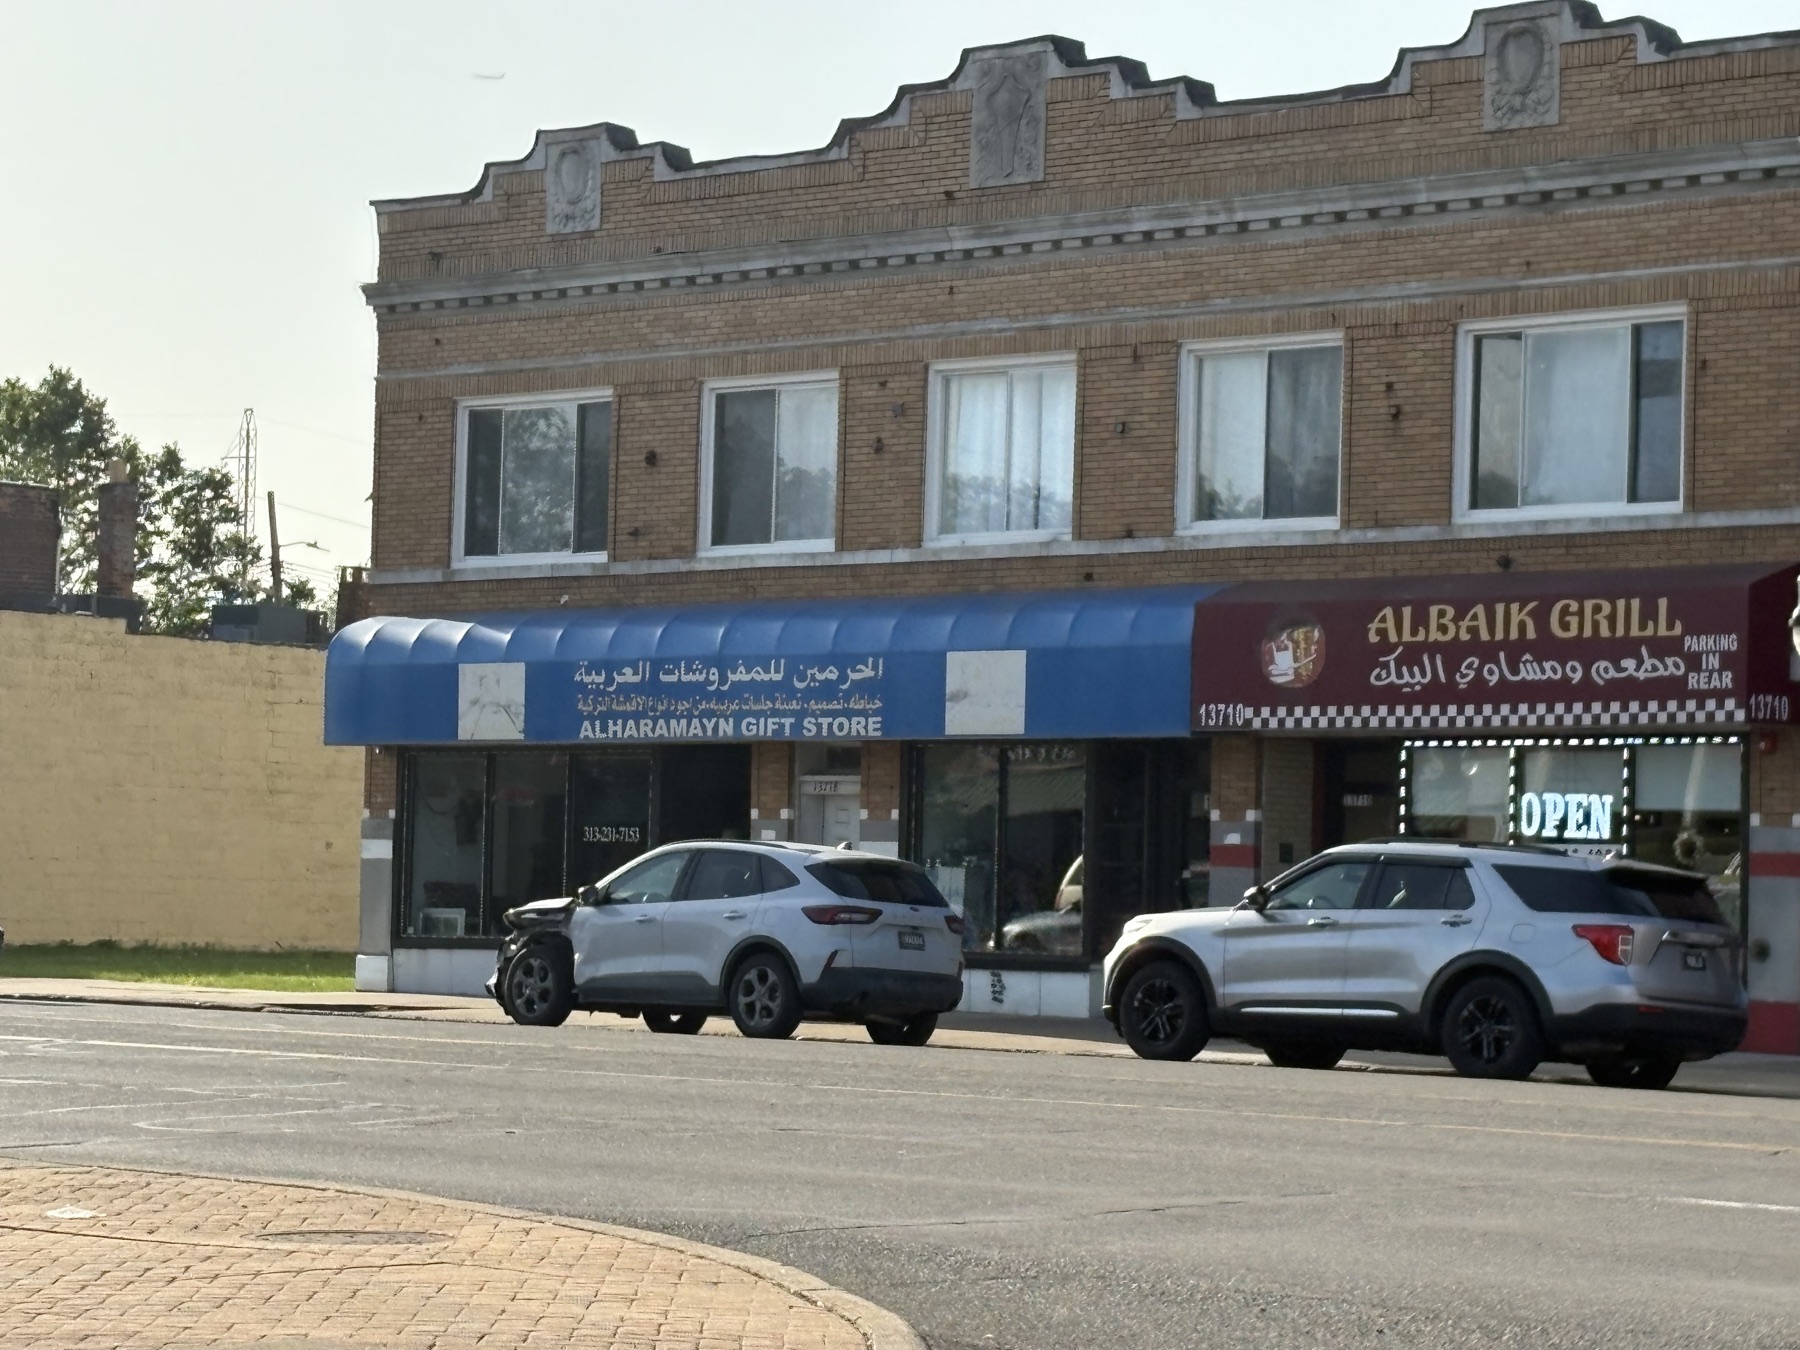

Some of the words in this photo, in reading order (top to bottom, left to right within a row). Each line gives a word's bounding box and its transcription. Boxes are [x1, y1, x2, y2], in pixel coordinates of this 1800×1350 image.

[1367, 601, 1539, 643] ALBAIK
[1549, 597, 1682, 638] GRILL
[1684, 633, 1738, 652] PARKING
[573, 660, 650, 691] العربية
[658, 658, 786, 691] للمفروشات
[793, 656, 884, 689] الحرمين
[1369, 646, 1446, 691] البيك
[1455, 651, 1583, 689] ومشاوي
[1591, 645, 1686, 685] مطعم
[1702, 652, 1720, 670] IN
[1687, 671, 1733, 690] REAR
[1199, 703, 1245, 726] 13710
[1748, 693, 1789, 721] 13710
[741, 716, 796, 737] GIFT
[802, 716, 883, 737] STORE
[1521, 791, 1613, 839] OPEN
